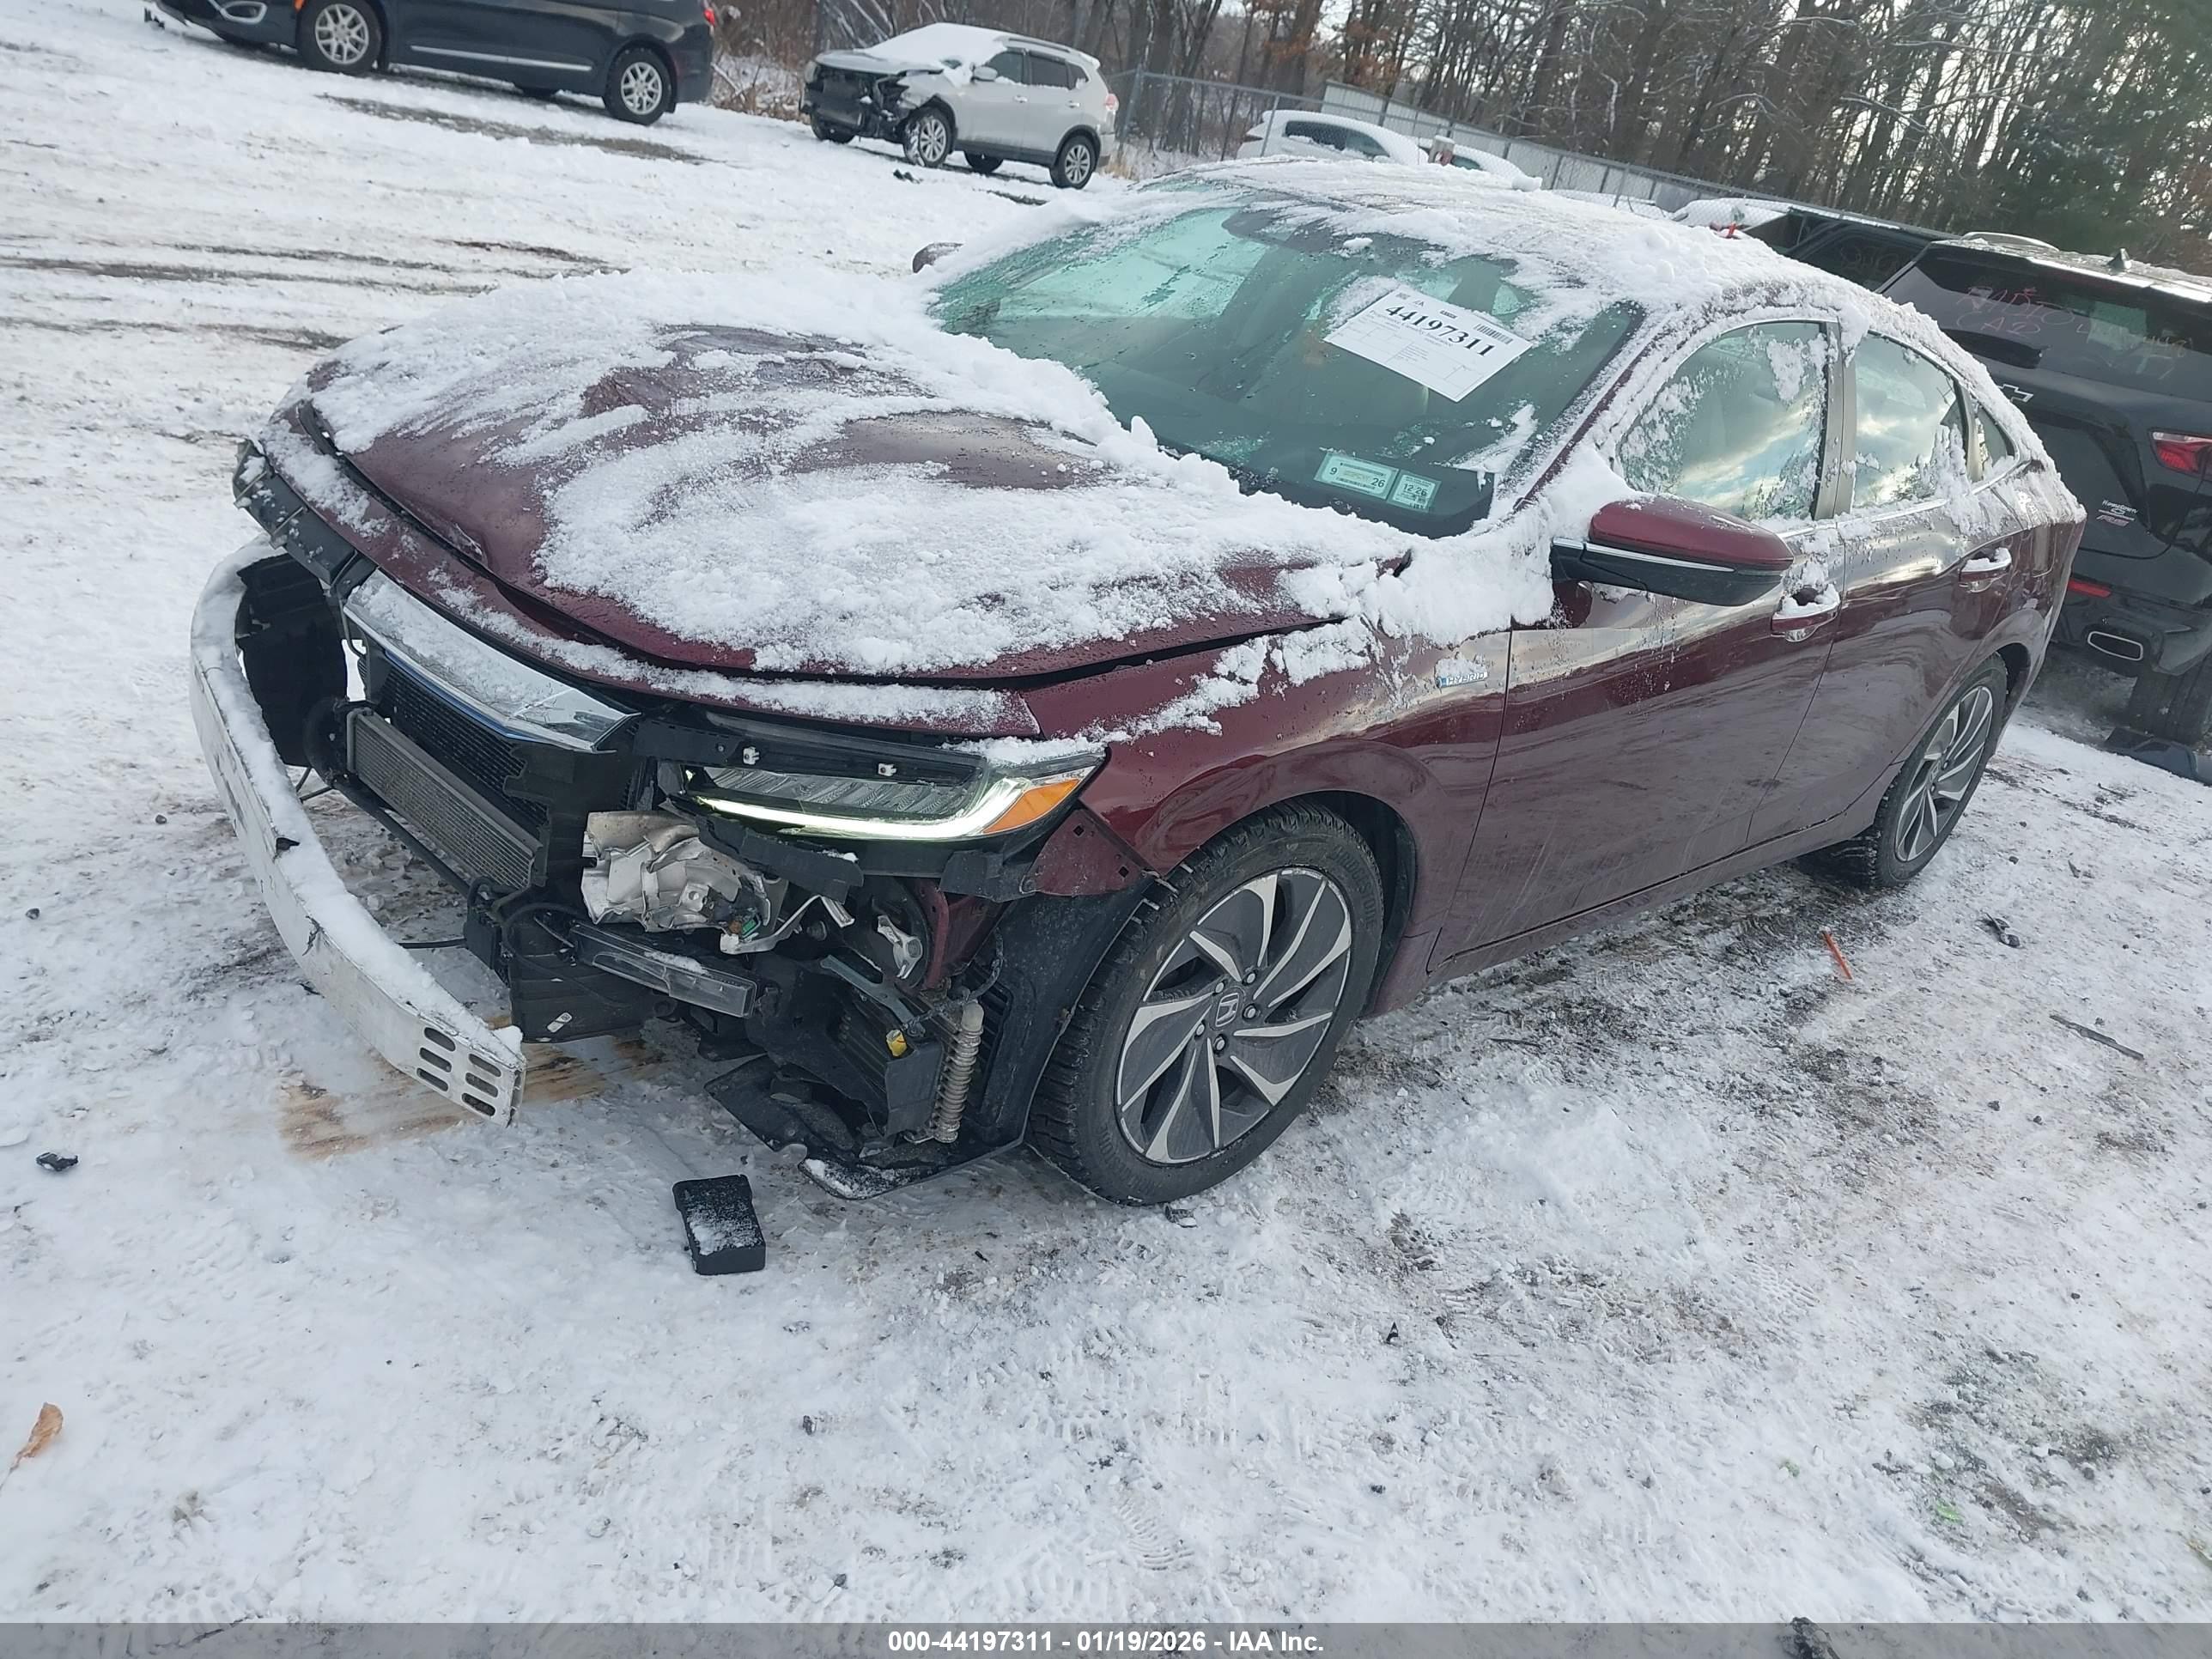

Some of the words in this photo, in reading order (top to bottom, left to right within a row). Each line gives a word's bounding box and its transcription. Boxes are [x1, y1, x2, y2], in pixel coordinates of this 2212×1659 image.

[1386, 306, 1496, 356] 44197311
[1329, 466, 1338, 476] 9
[1370, 477, 1386, 488] 26
